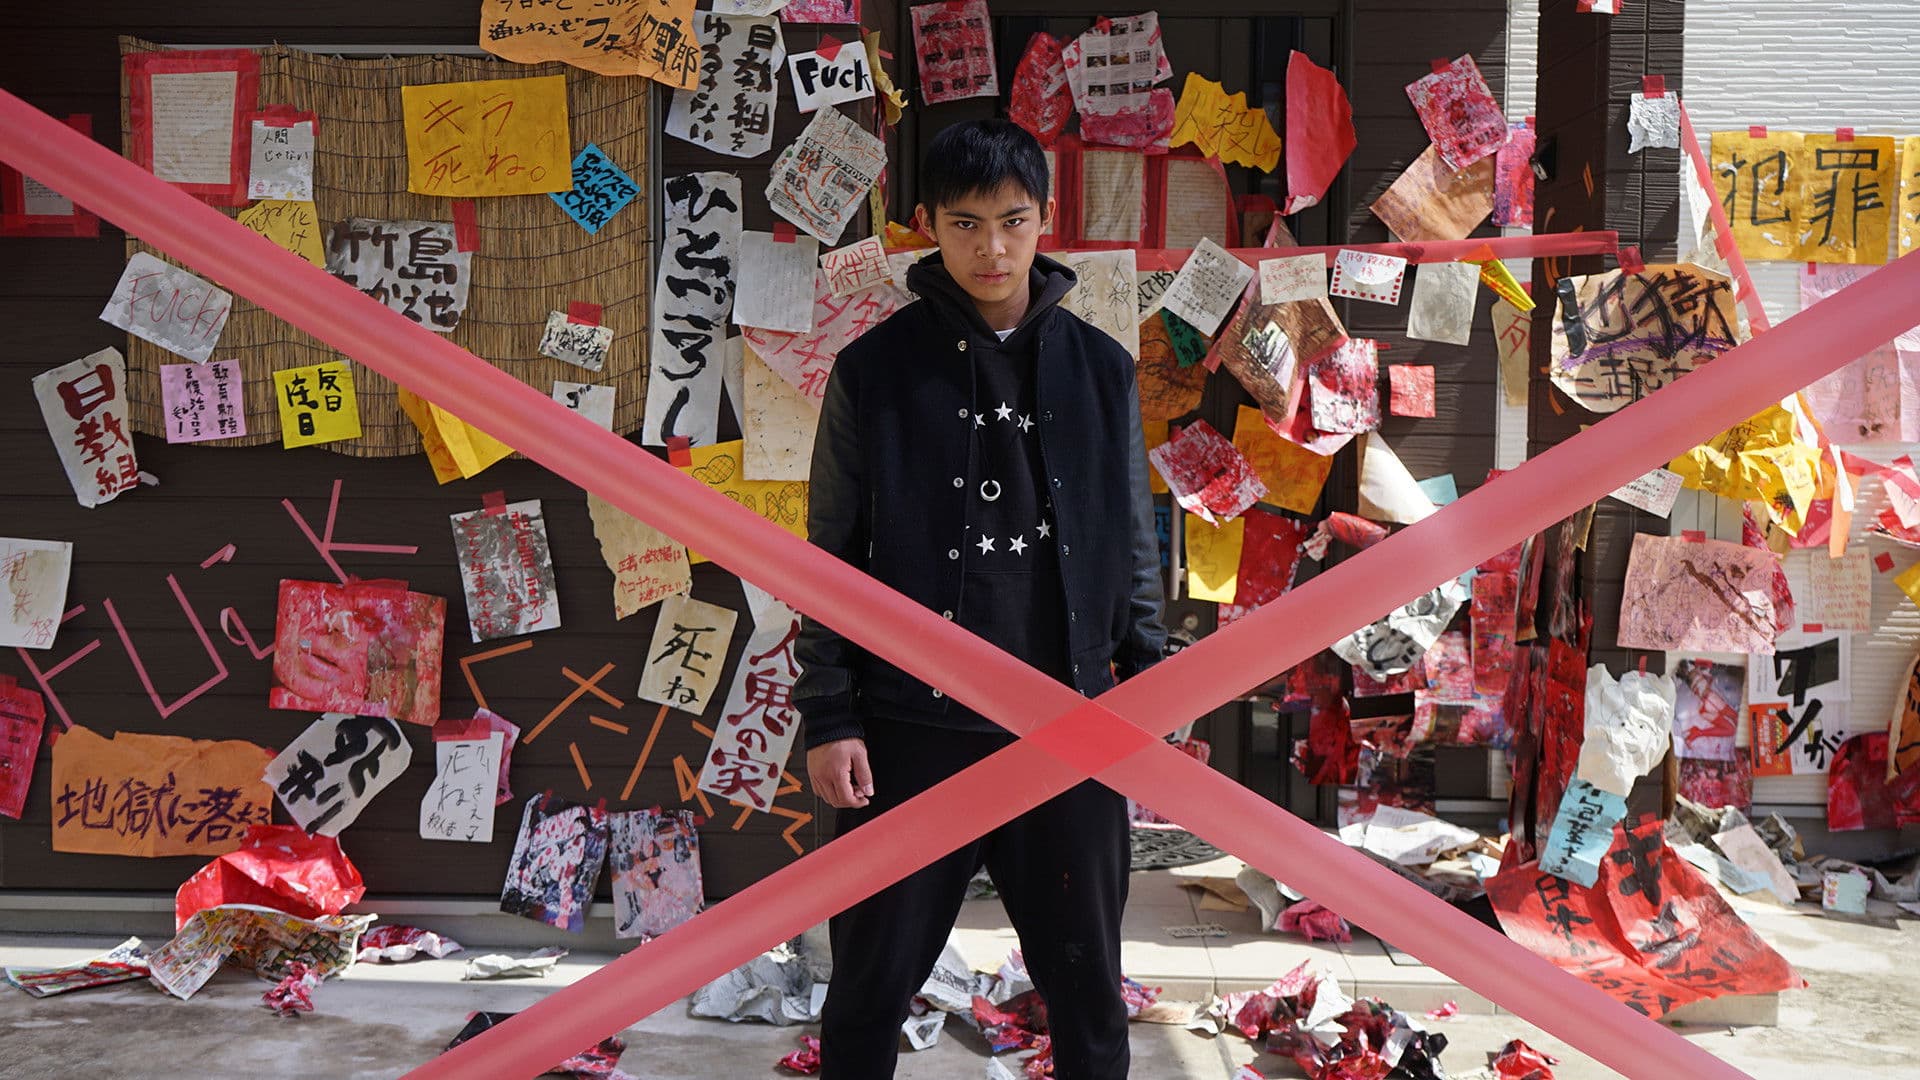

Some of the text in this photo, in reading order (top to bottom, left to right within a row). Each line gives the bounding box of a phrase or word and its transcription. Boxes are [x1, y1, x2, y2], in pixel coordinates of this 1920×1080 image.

[796, 57, 872, 96] Fuck
[263, 128, 289, 145] 人間
[330, 221, 457, 285] 竹島
[317, 368, 342, 412] 反日
[57, 364, 141, 496] 日教組
[652, 622, 717, 704] 死ね
